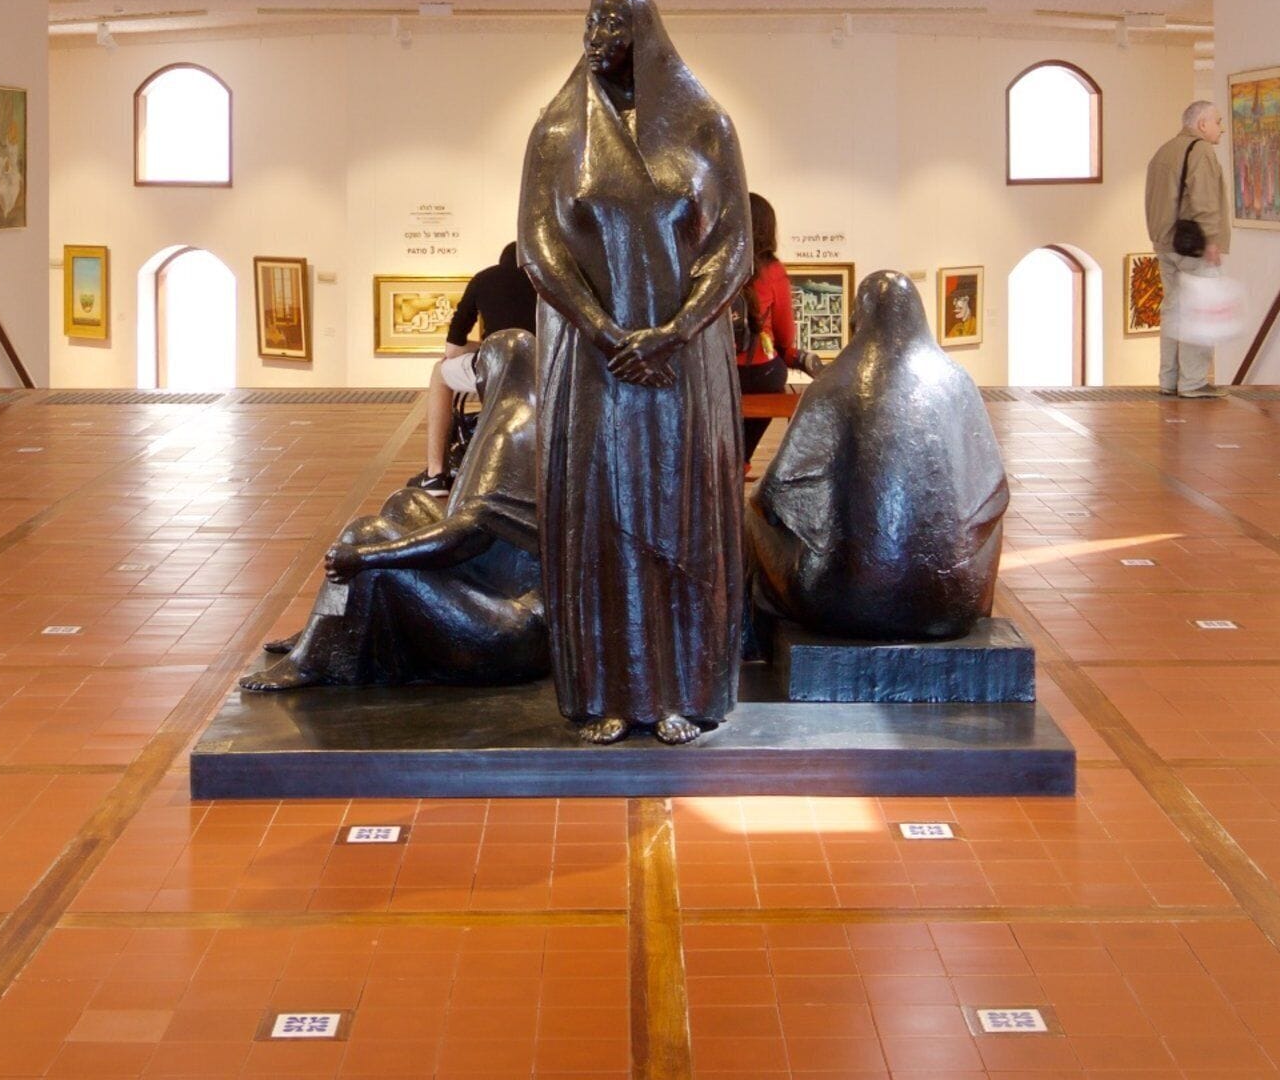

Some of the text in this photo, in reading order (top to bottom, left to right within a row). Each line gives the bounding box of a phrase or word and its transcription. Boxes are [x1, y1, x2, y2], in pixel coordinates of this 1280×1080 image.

[407, 247, 428, 255] PATIO
[430, 245, 435, 255] 3
[816, 249, 821, 258] 2
